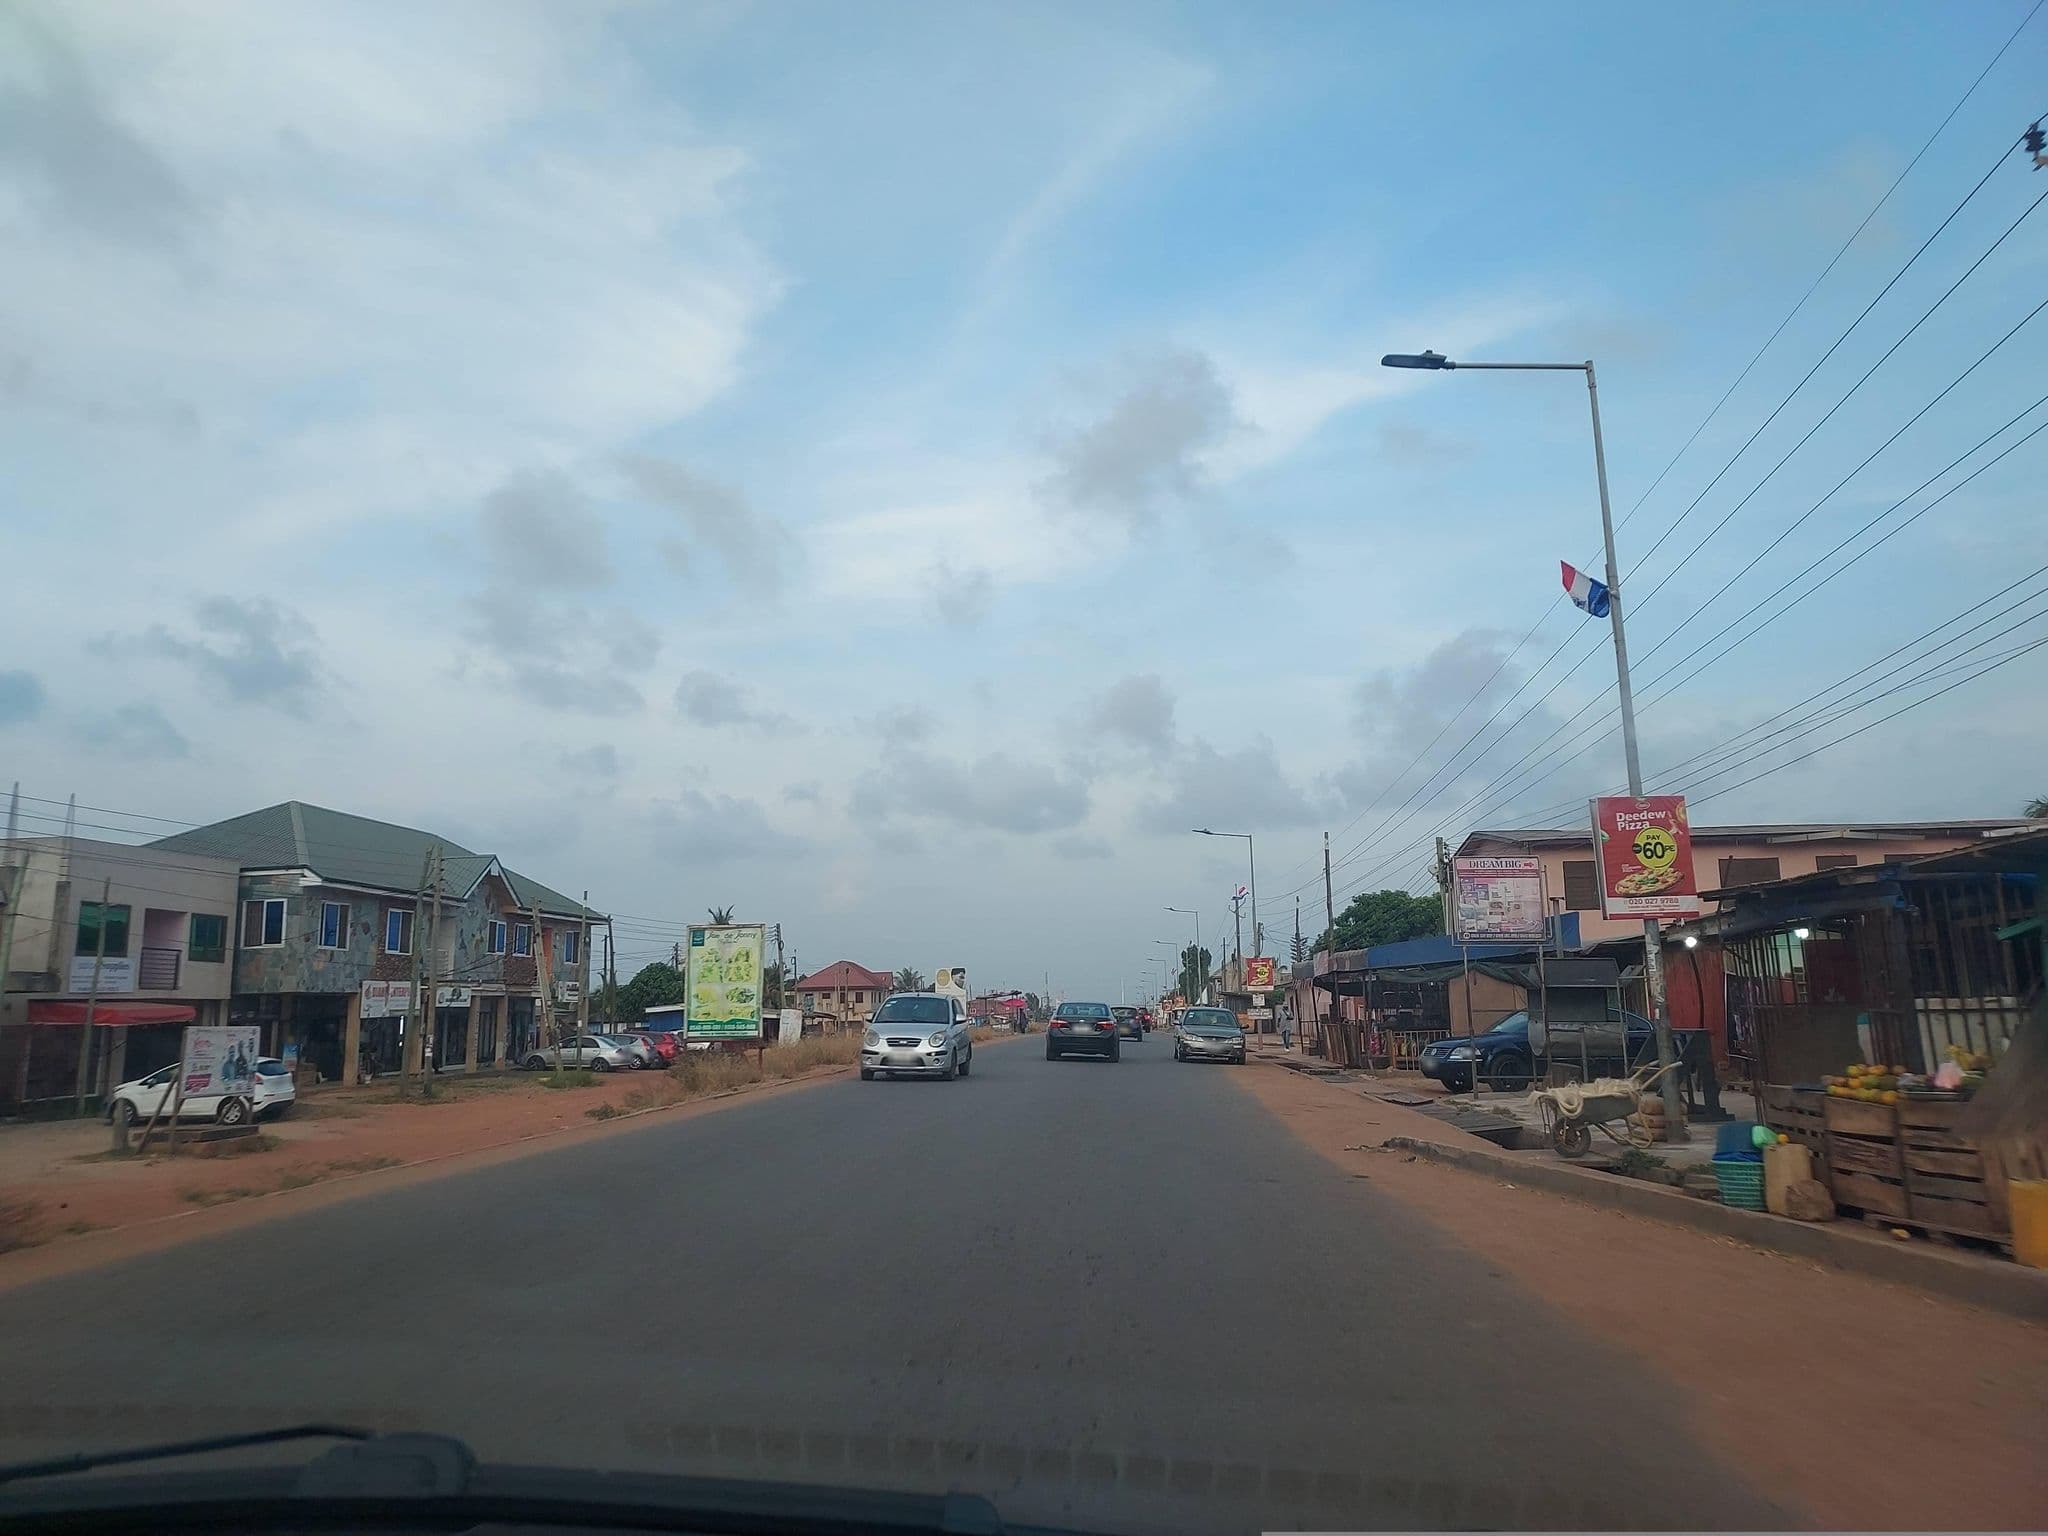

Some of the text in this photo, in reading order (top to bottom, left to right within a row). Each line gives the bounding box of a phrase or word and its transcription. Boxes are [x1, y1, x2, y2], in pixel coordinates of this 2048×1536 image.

[1616, 811, 1666, 821] Deedew
[1617, 821, 1650, 831] Pizza
[1643, 842, 1665, 859] 60
[1469, 860, 1521, 868] DREAM BIG
